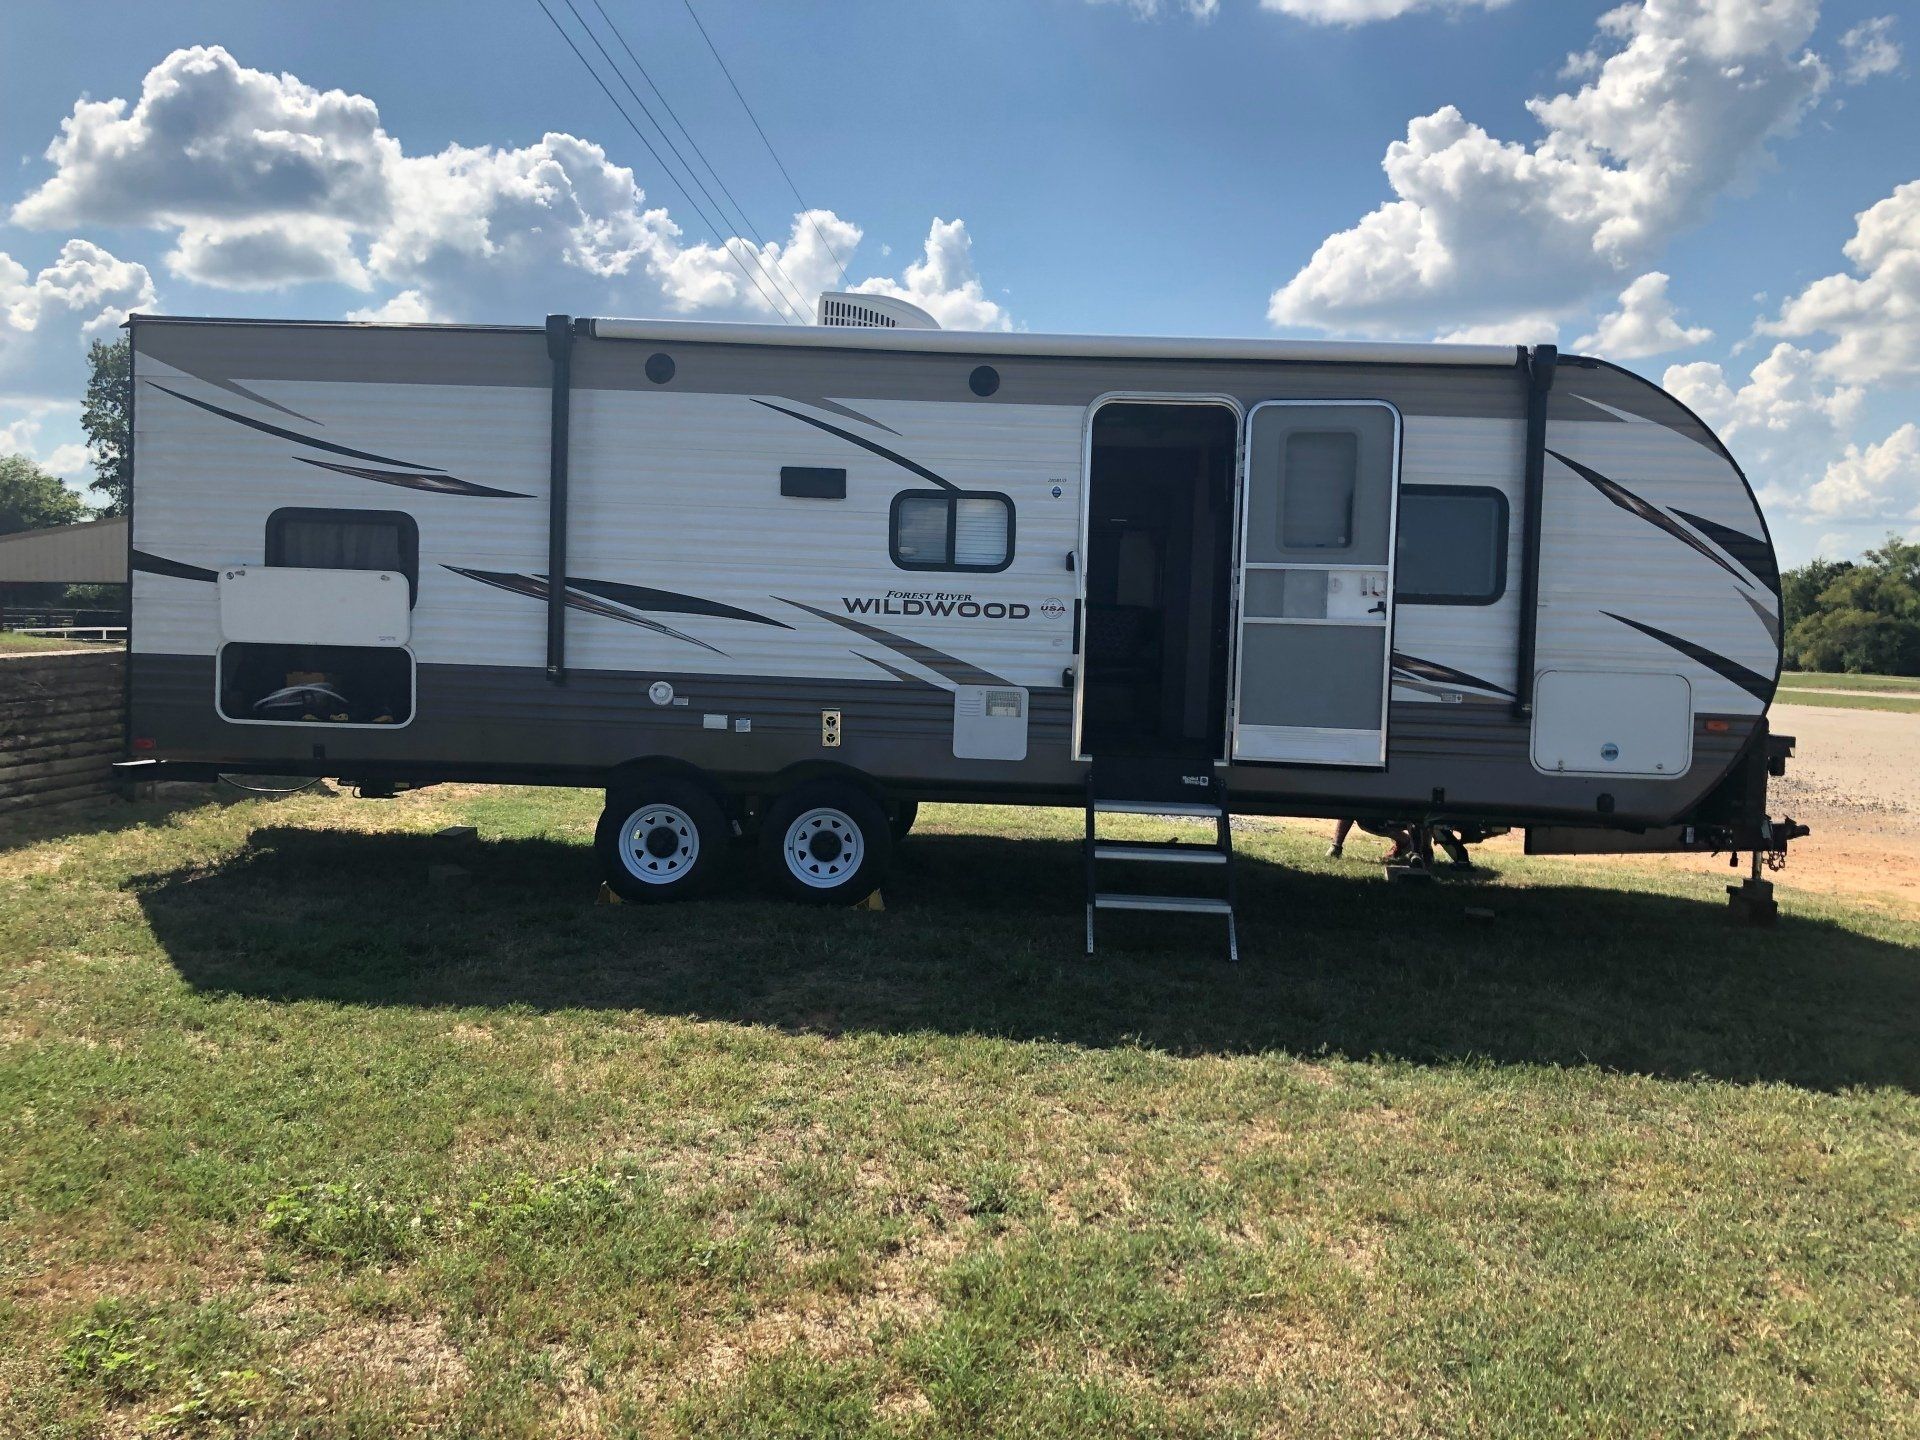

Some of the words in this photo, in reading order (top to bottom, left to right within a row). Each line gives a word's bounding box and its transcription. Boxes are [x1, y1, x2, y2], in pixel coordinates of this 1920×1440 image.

[885, 590, 933, 600] FOREST
[934, 592, 973, 601] RIVER
[841, 597, 1030, 619] WILDWOOD
